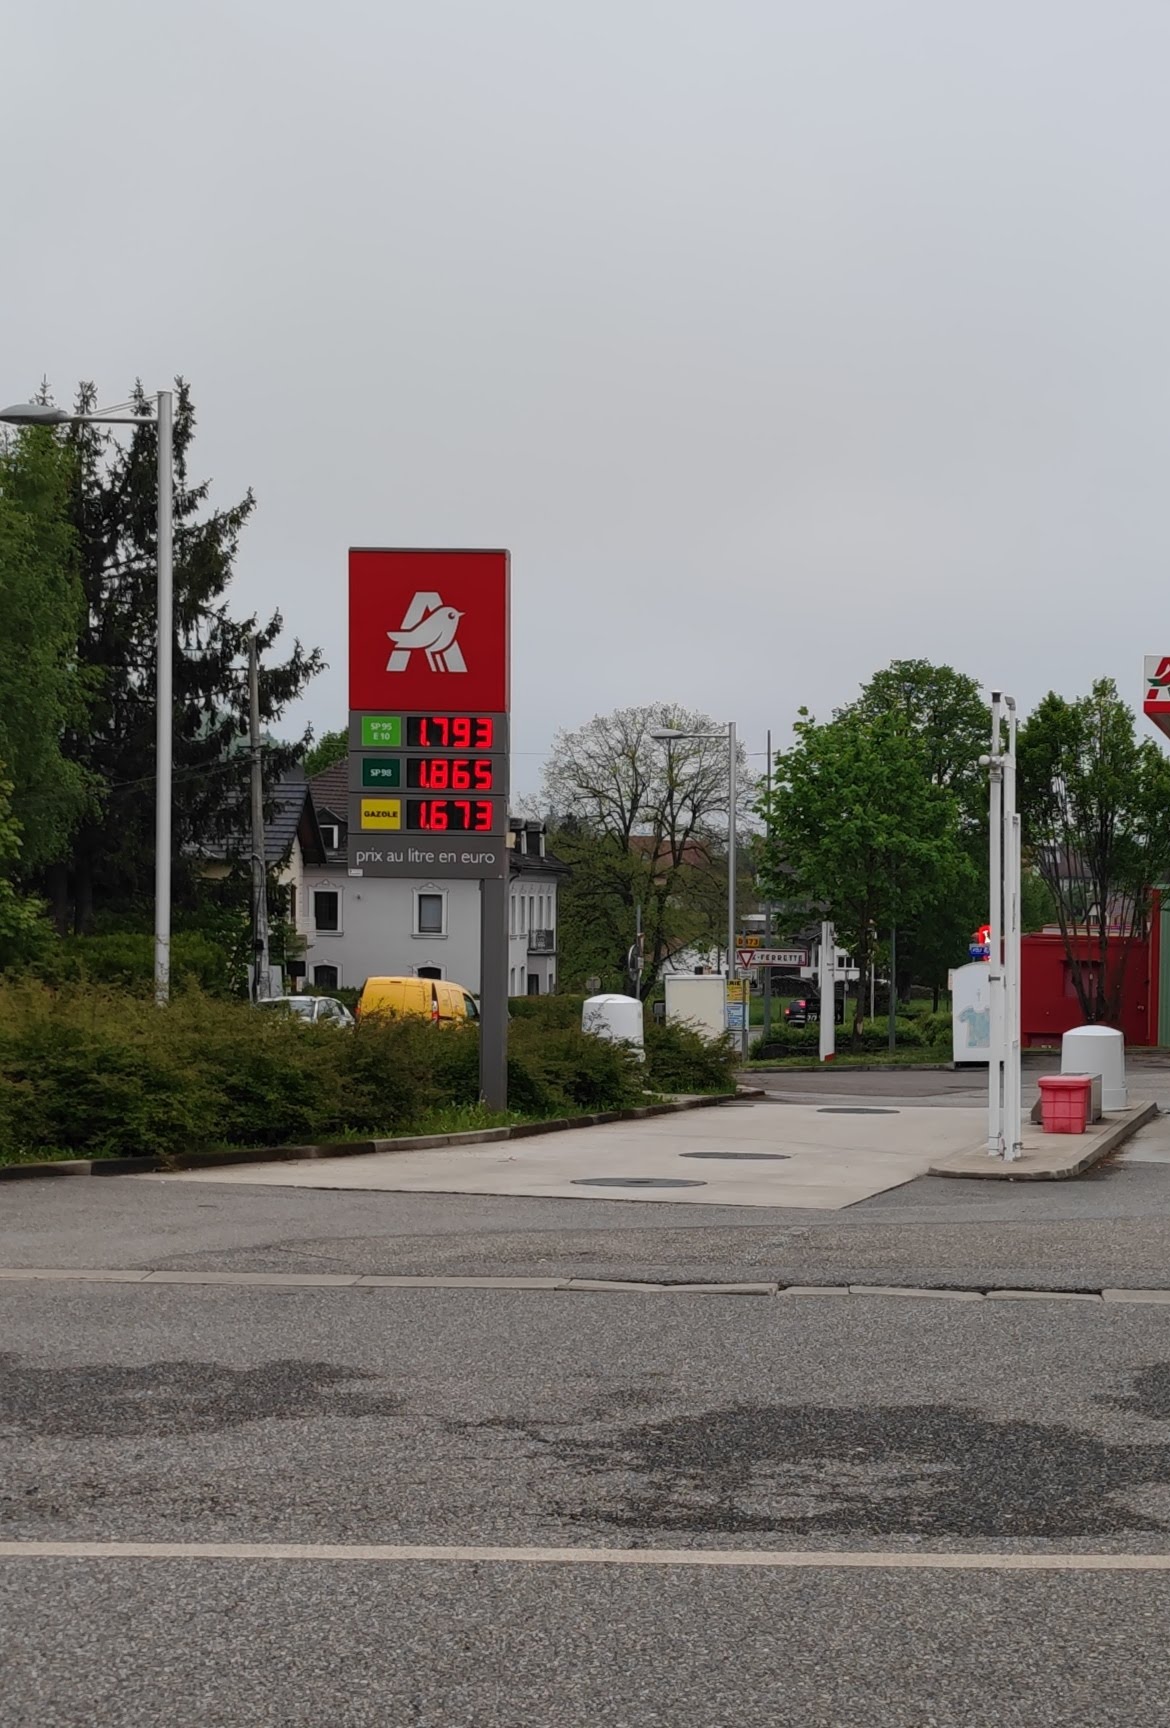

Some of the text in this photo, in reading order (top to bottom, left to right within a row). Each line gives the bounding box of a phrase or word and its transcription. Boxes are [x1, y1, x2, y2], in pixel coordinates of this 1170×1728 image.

[373, 732, 391, 741] E 10
[420, 717, 493, 748] 1.793
[420, 759, 493, 789] 1.865
[363, 810, 399, 818] GAZOLE
[419, 800, 493, 831] 1.673
[356, 848, 496, 865] prix au litre en euro
